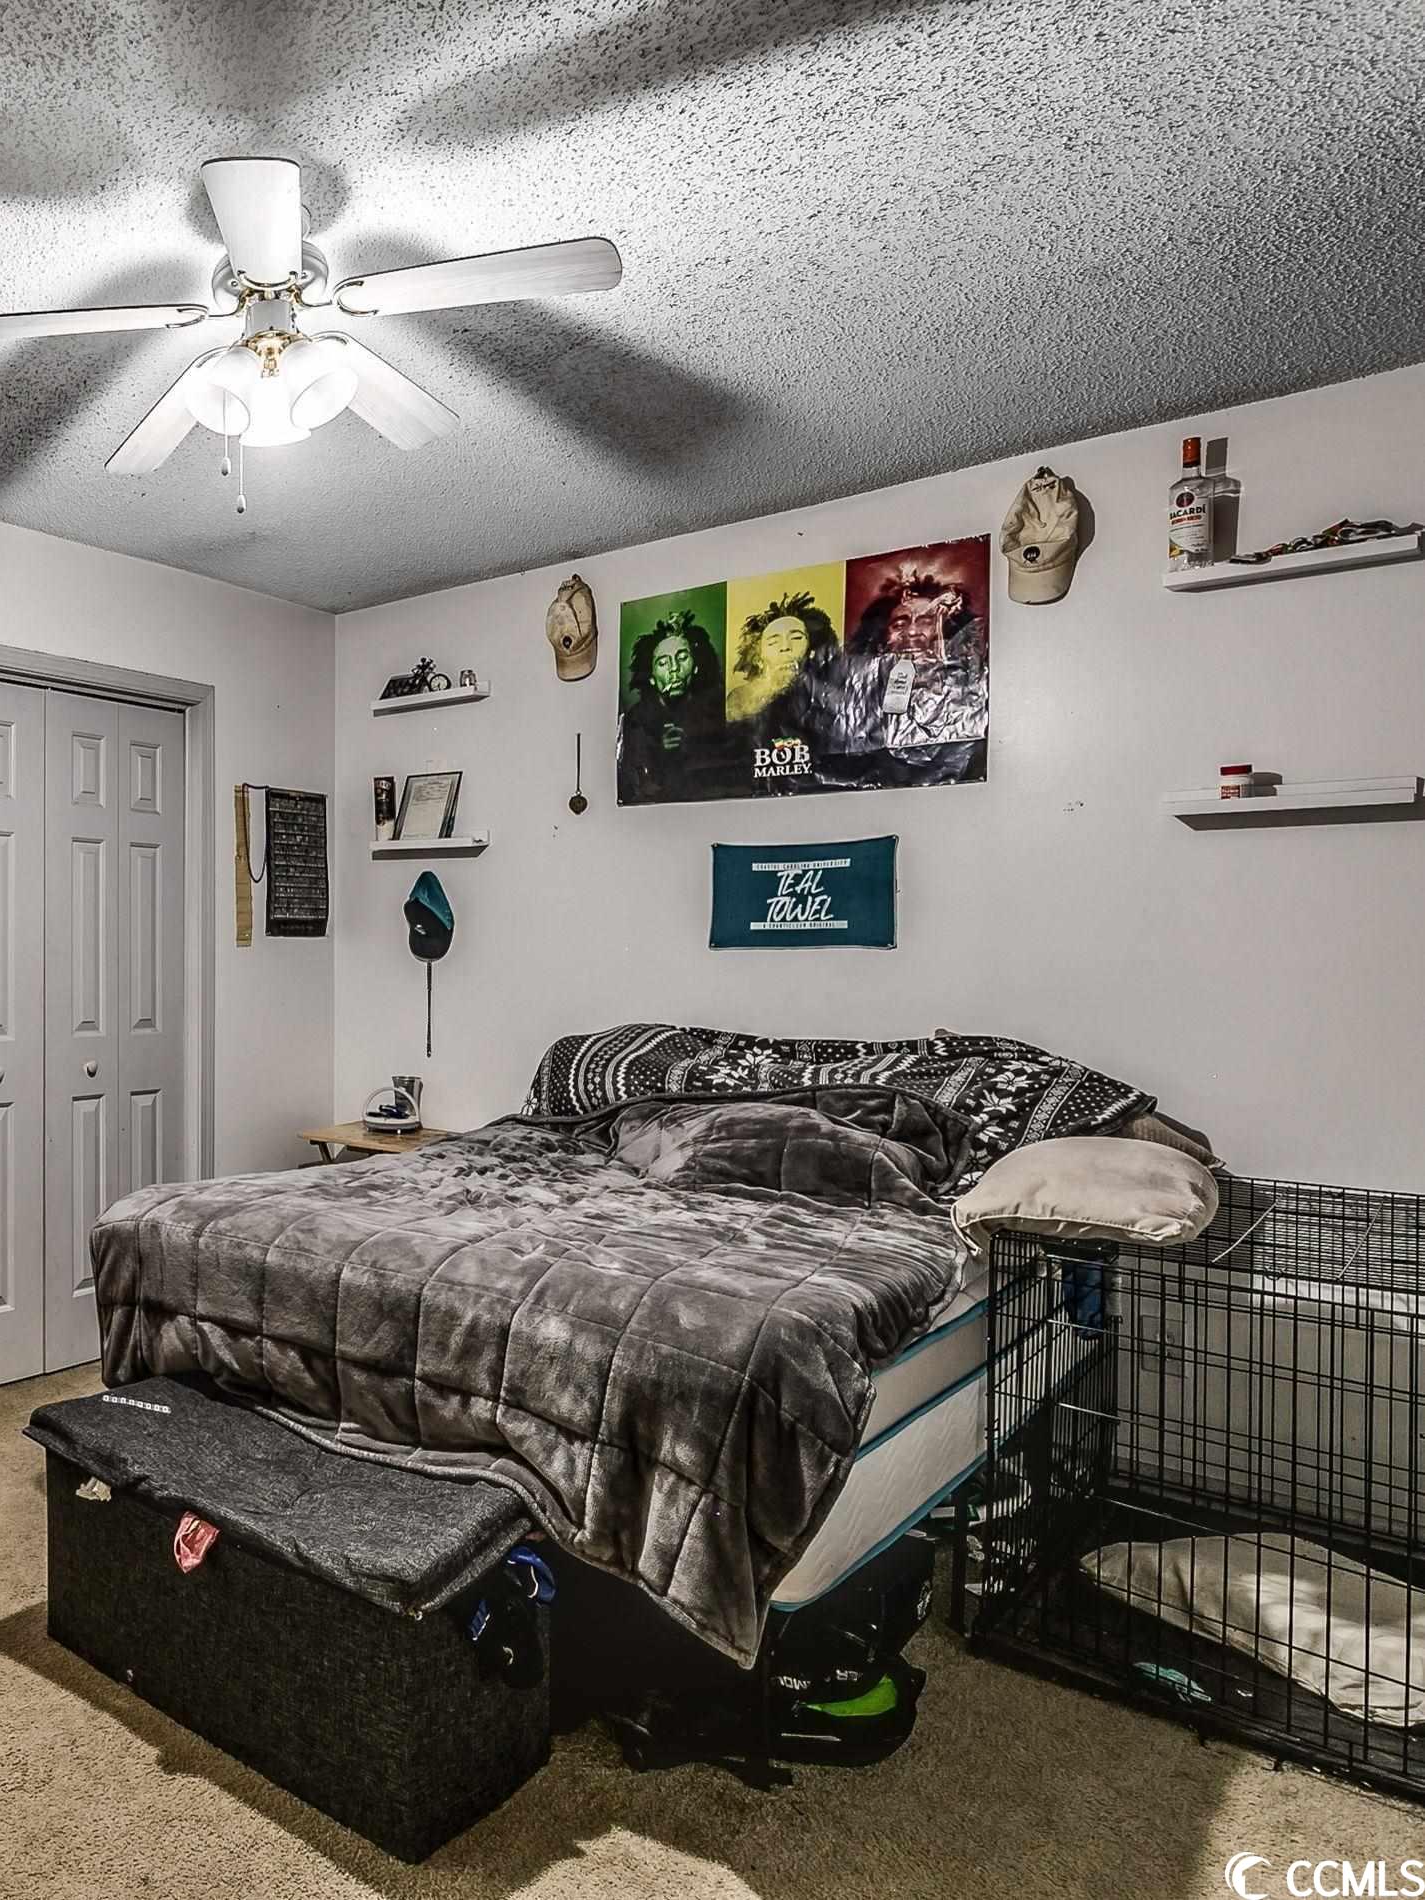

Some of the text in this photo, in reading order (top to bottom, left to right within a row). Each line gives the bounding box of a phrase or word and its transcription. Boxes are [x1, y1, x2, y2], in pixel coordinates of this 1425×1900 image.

[753, 745, 811, 767] BOB
[776, 869, 825, 896] TEAL
[766, 895, 834, 922] TOWEL
